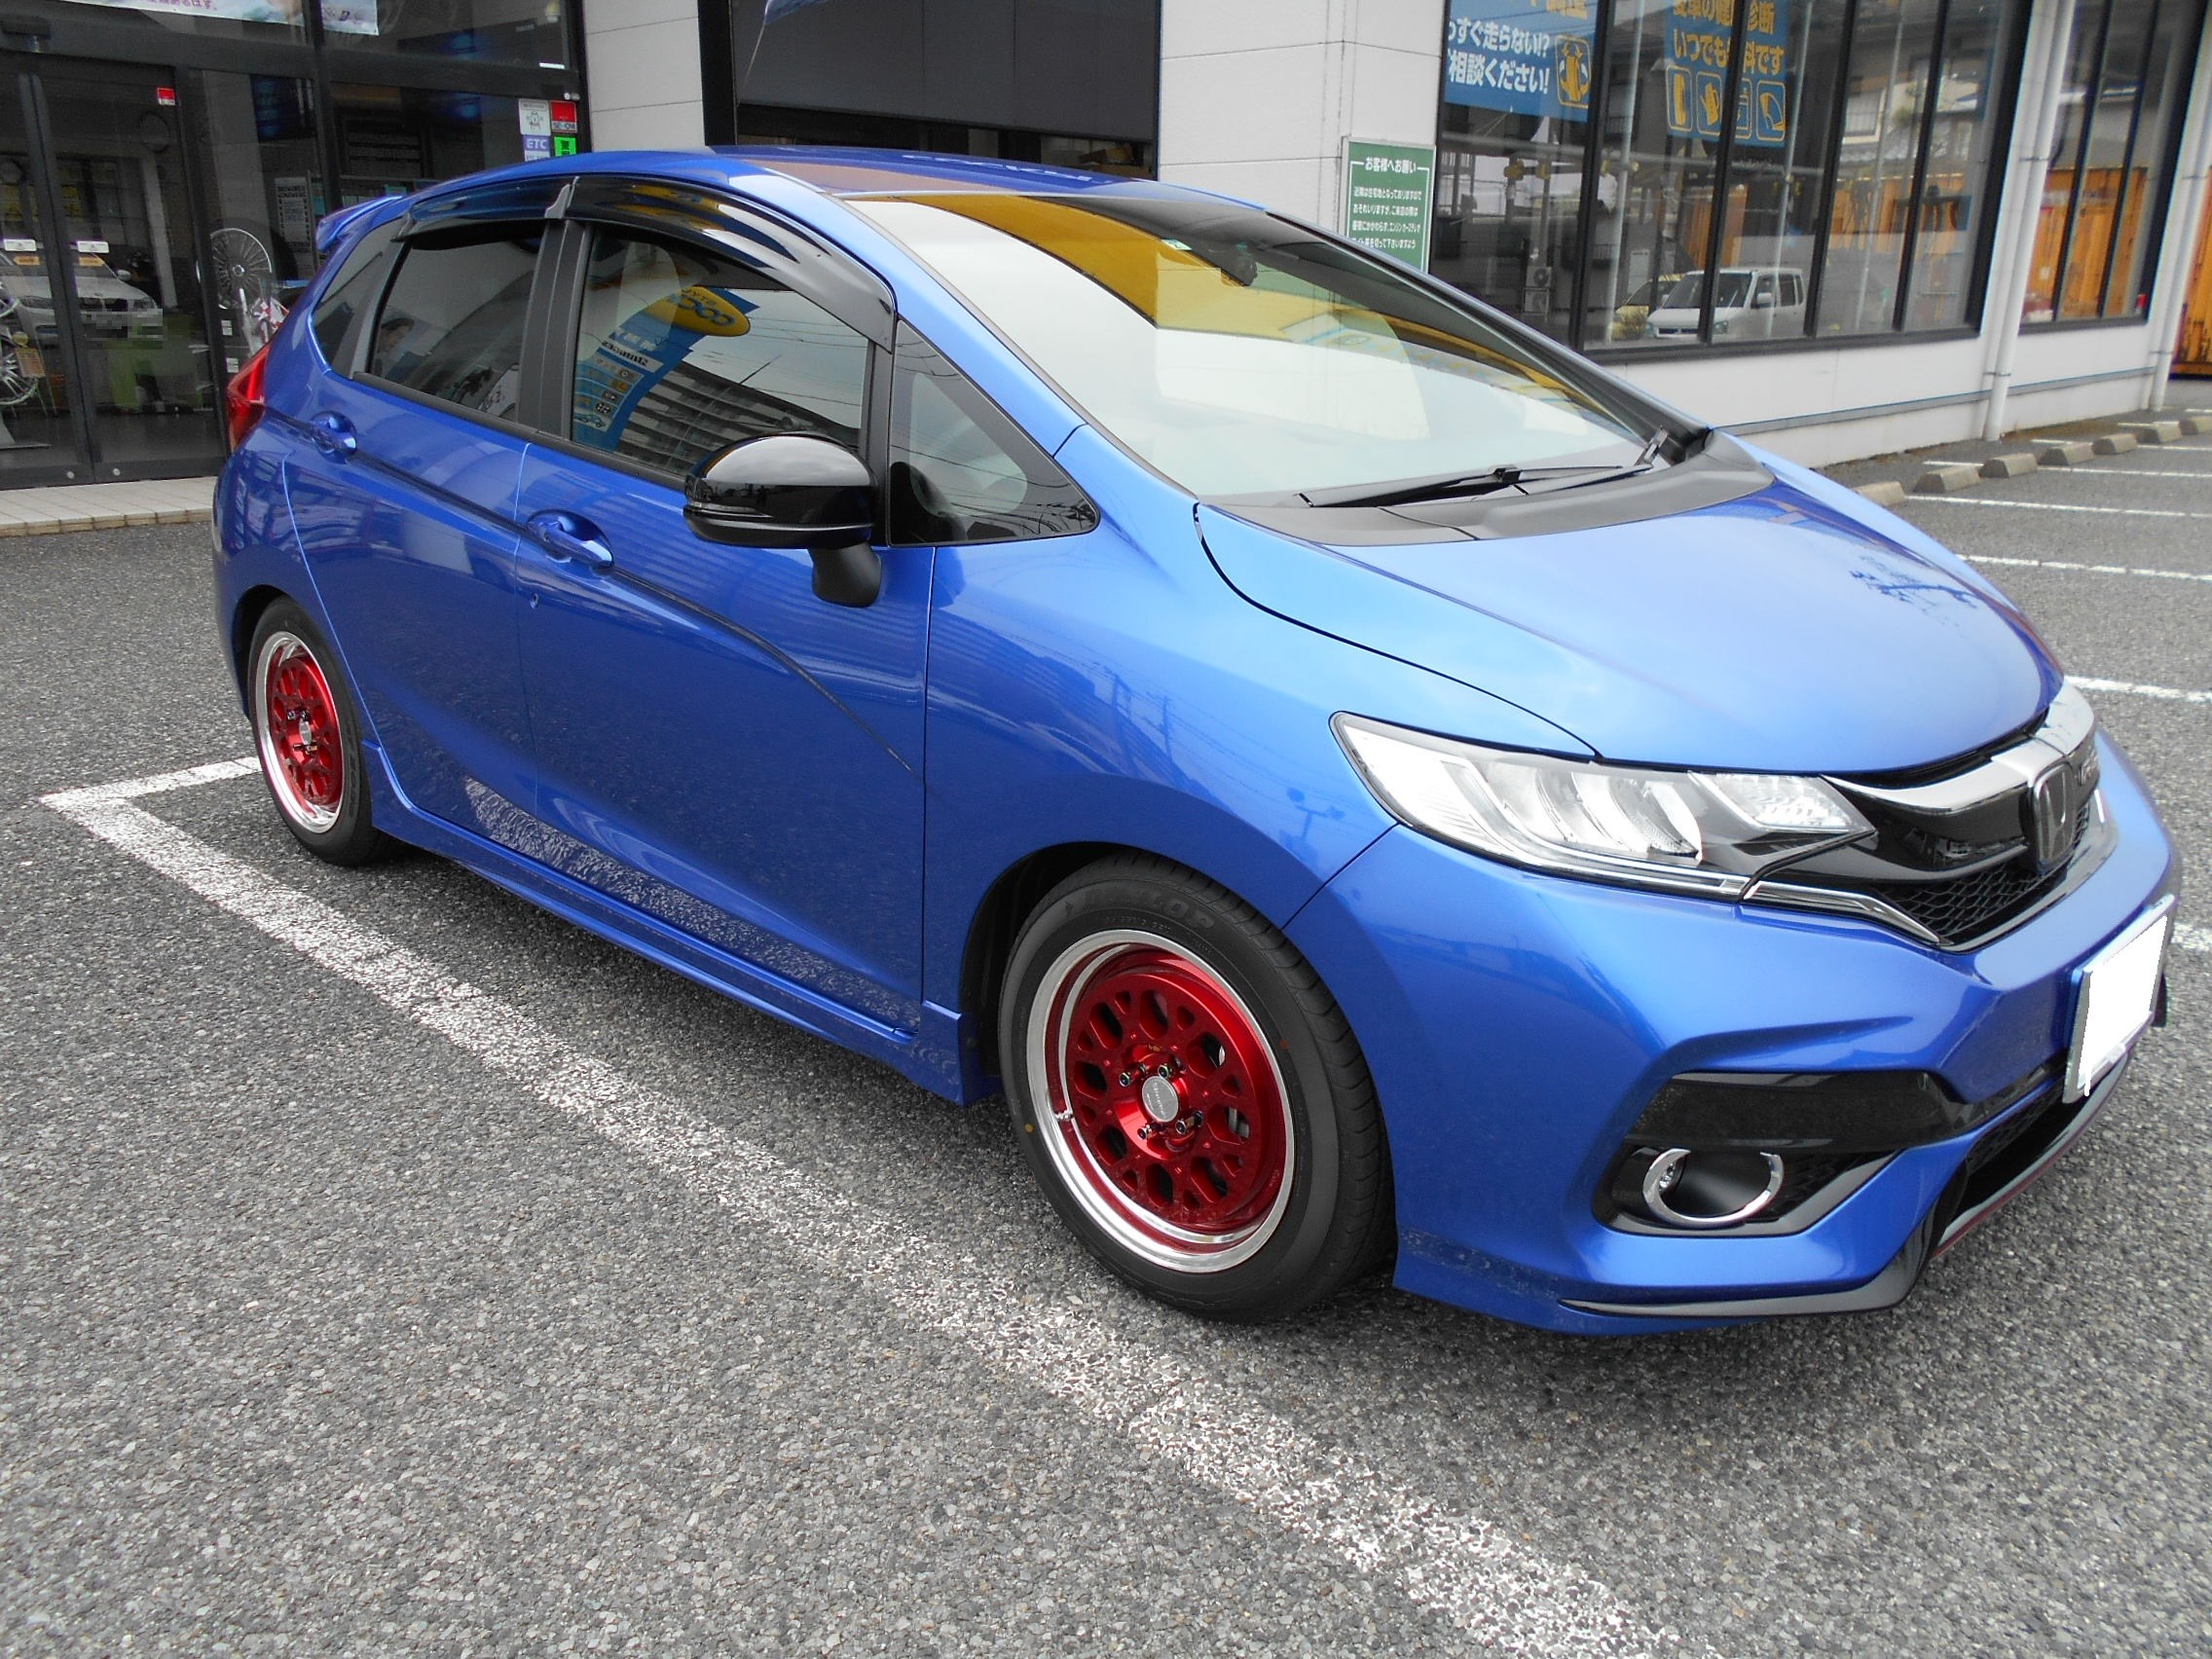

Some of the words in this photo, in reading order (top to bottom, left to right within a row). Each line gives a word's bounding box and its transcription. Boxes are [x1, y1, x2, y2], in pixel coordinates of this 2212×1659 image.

[1674, 28, 1785, 76] いつでも料です
[1447, 48, 1550, 94] 相談ください!
[526, 138, 547, 149] ETC
[1364, 156, 1417, 174] お客様へお願い
